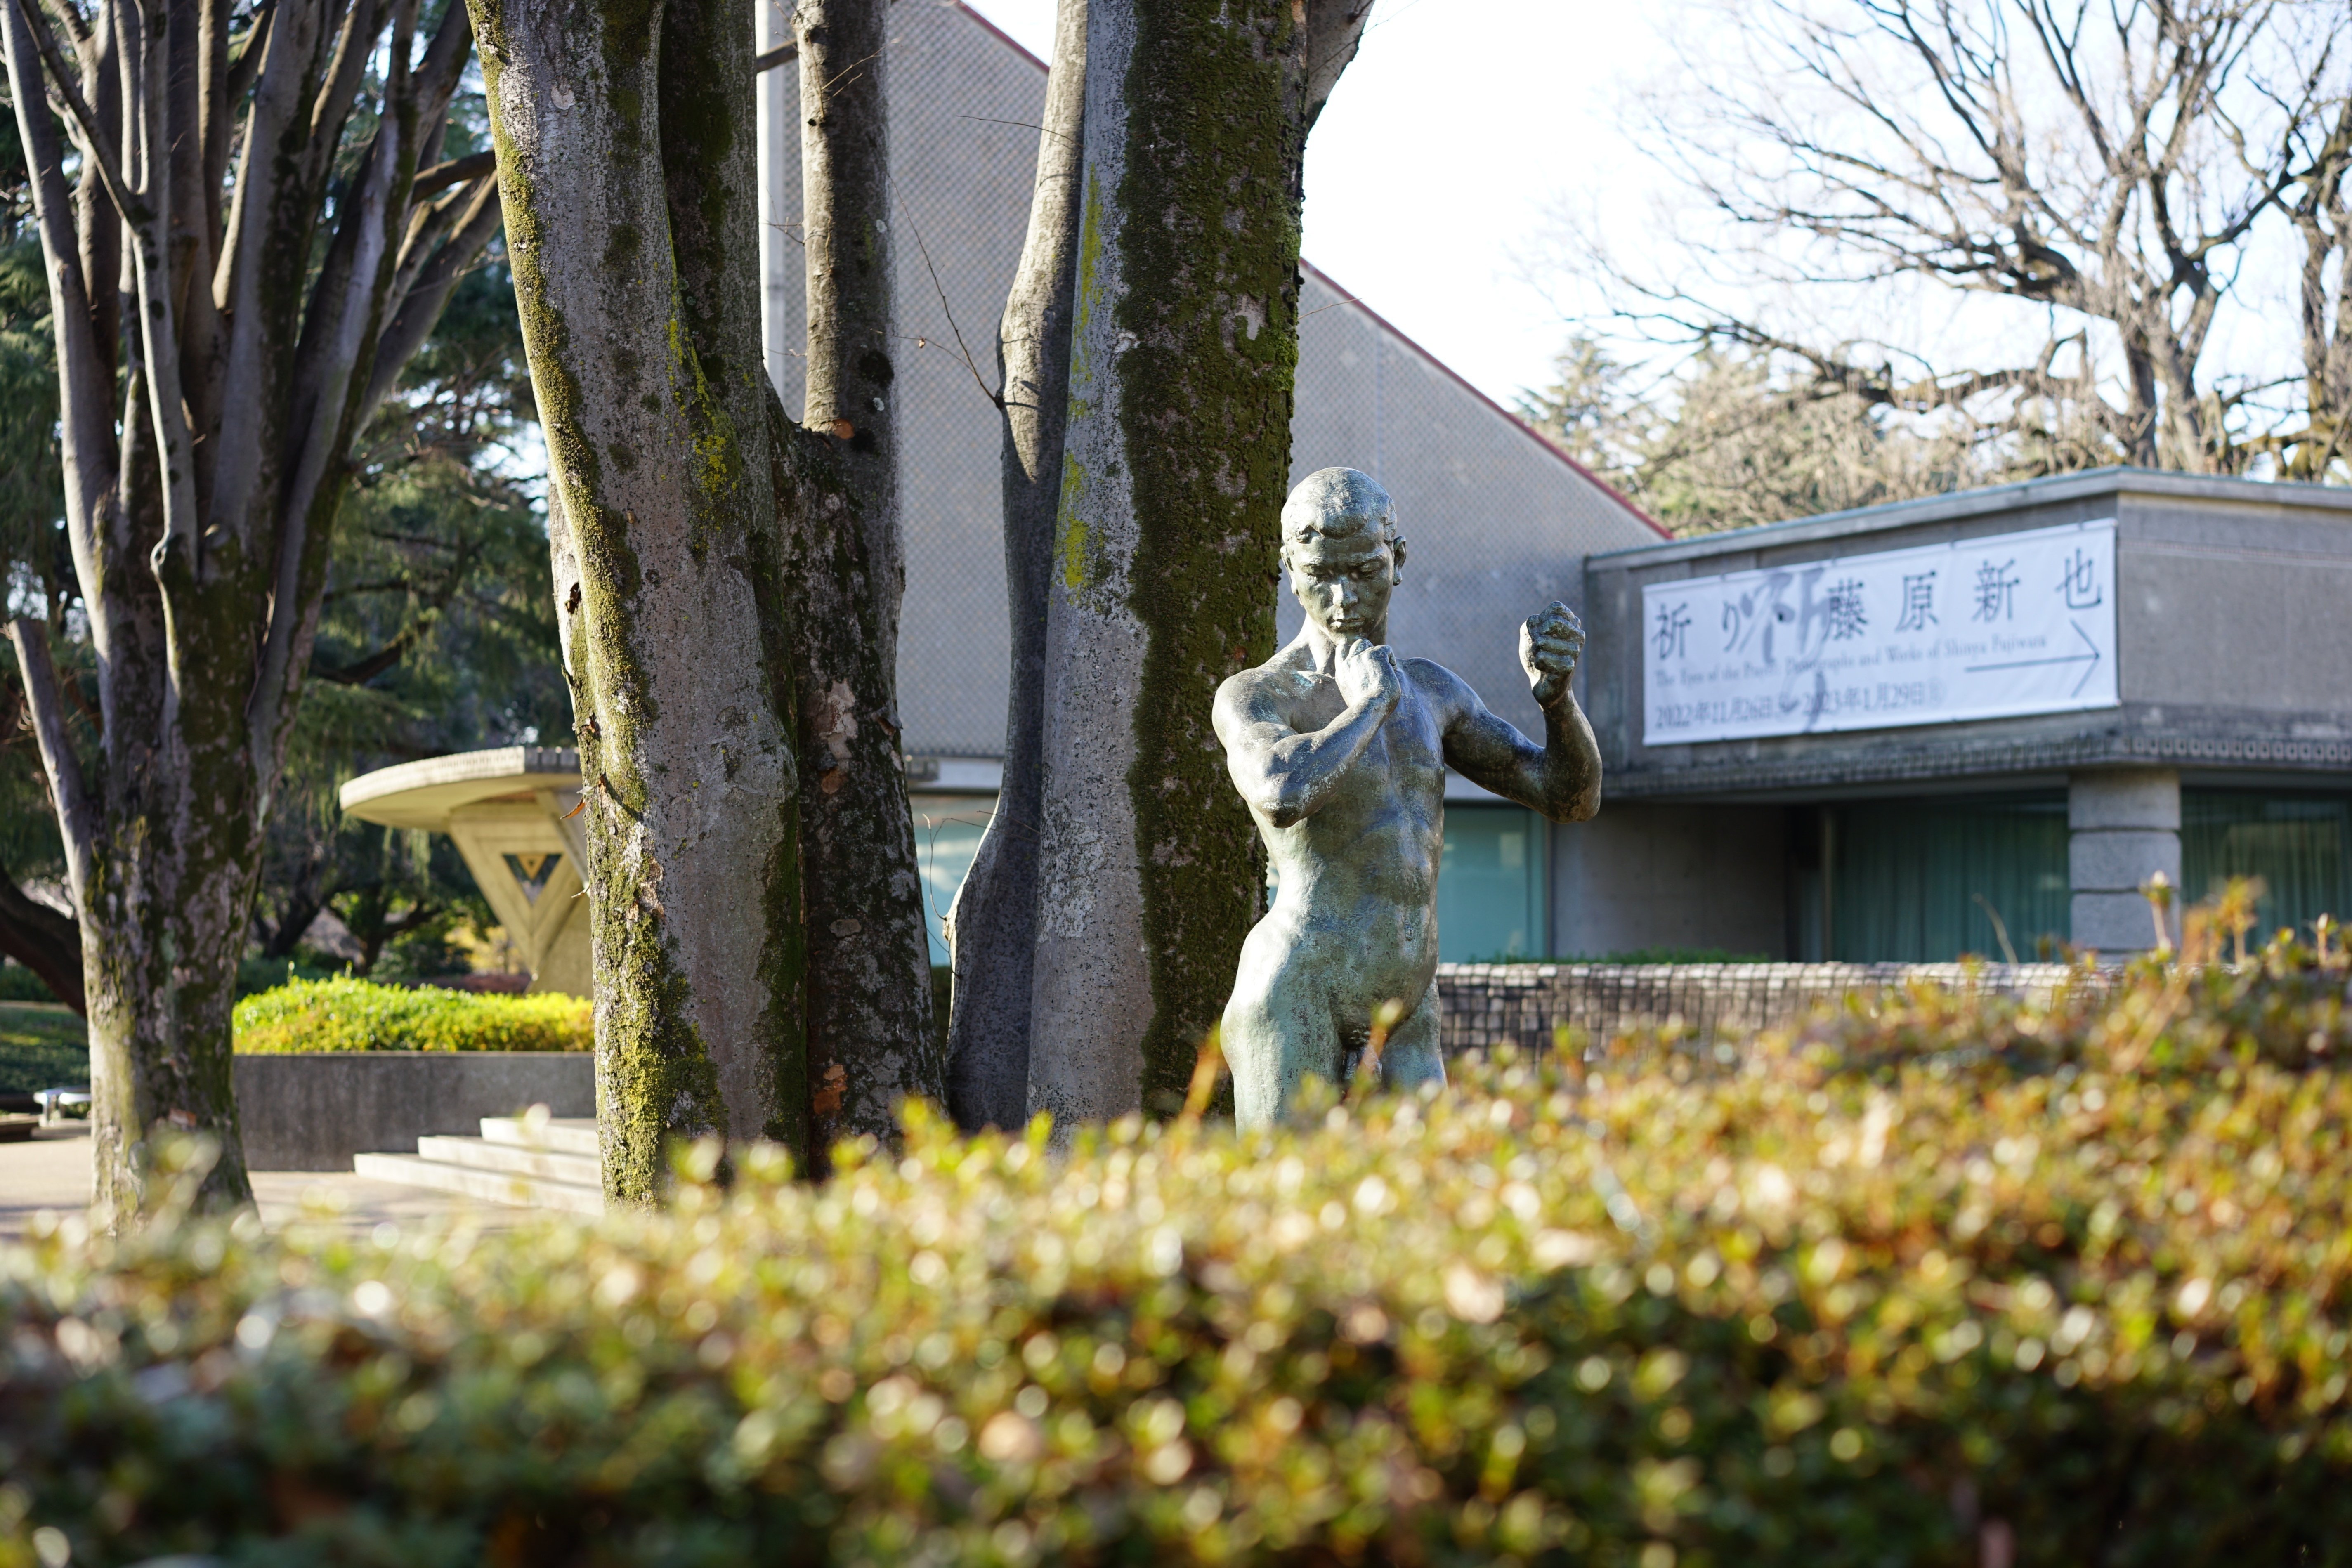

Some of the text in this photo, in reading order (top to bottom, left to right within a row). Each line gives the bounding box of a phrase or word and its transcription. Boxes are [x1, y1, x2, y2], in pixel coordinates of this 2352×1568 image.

[1651, 546, 2102, 660] 祈り 藤原新也
[1859, 646, 1878, 666] and
[1928, 638, 1939, 658] of
[1944, 637, 1988, 660] Shinya
[1991, 633, 2046, 654] Fujiwara
